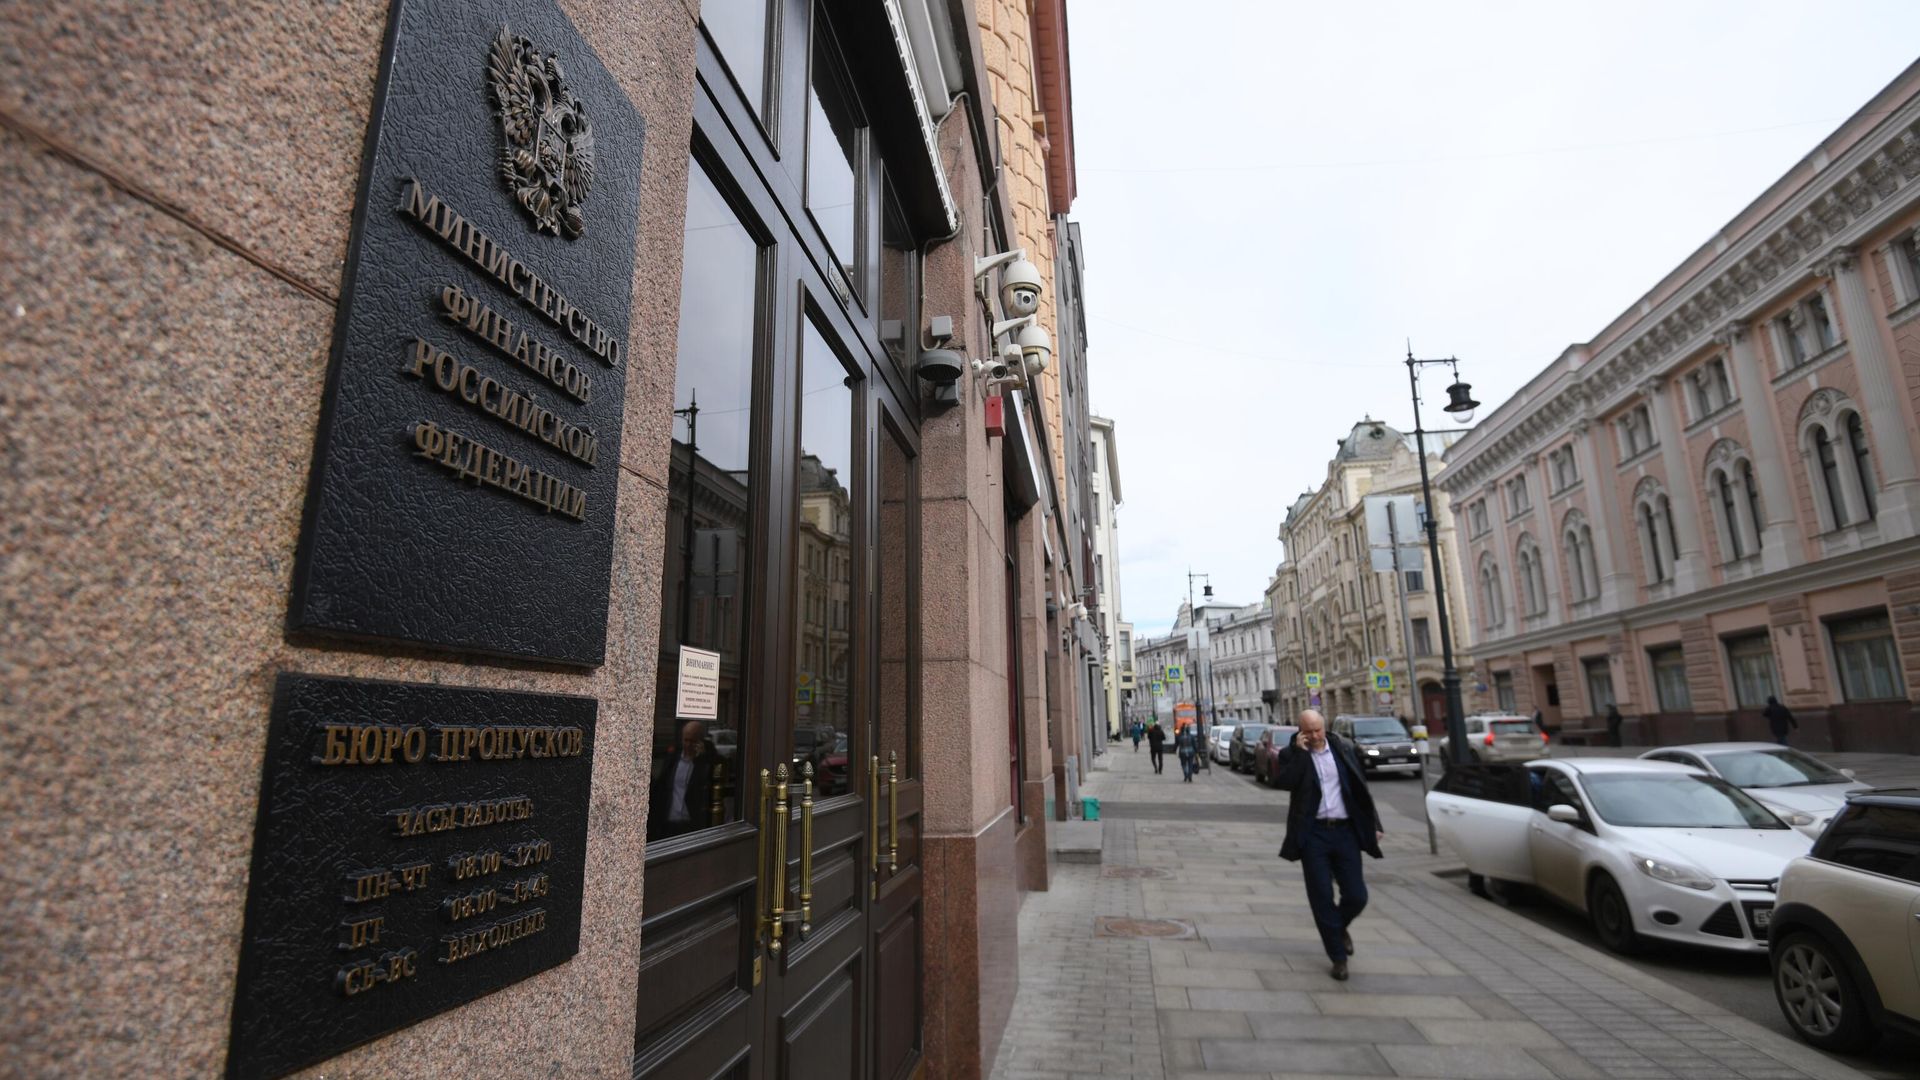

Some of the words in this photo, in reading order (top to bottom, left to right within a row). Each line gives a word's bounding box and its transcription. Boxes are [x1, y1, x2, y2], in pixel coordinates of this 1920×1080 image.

[405, 177, 620, 366] МИНИСТЕРСТВО
[441, 284, 592, 403] ФИНАНСОВ
[410, 336, 598, 467] РОССИЙСКОЙ
[413, 419, 588, 522] ФЕДЕРАЦИИ
[321, 725, 427, 765] БЮРО
[436, 726, 584, 762] ПРОПУСКОВ
[397, 807, 456, 837] ЧАСЫ
[350, 917, 385, 949] ПТ
[447, 911, 546, 963] ВЫХОДНЫЕ
